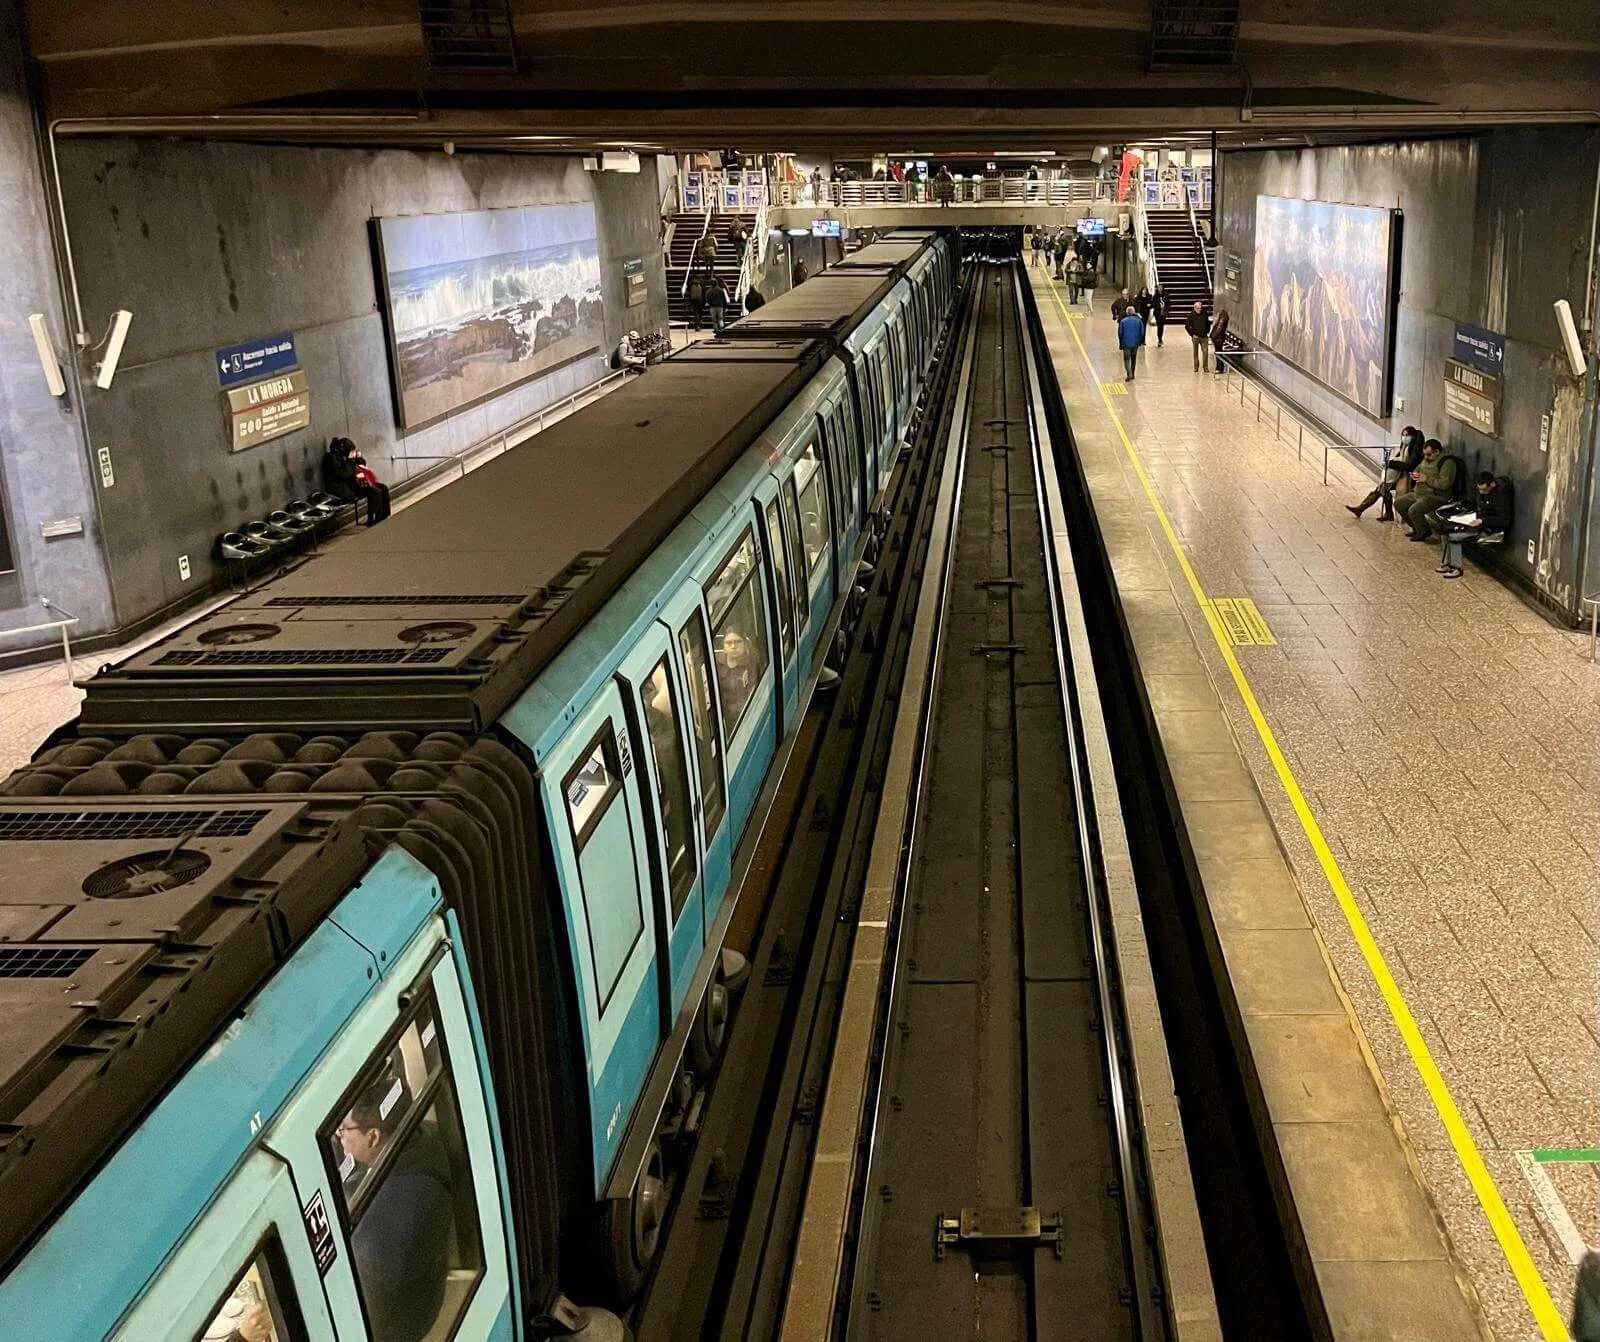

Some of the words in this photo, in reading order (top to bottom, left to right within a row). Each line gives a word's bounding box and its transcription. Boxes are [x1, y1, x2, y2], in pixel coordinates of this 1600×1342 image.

[1454, 366, 1461, 381] LA
[248, 389, 260, 404] LA
[260, 378, 294, 401] MONEDA
[249, 1111, 262, 1136] AT
